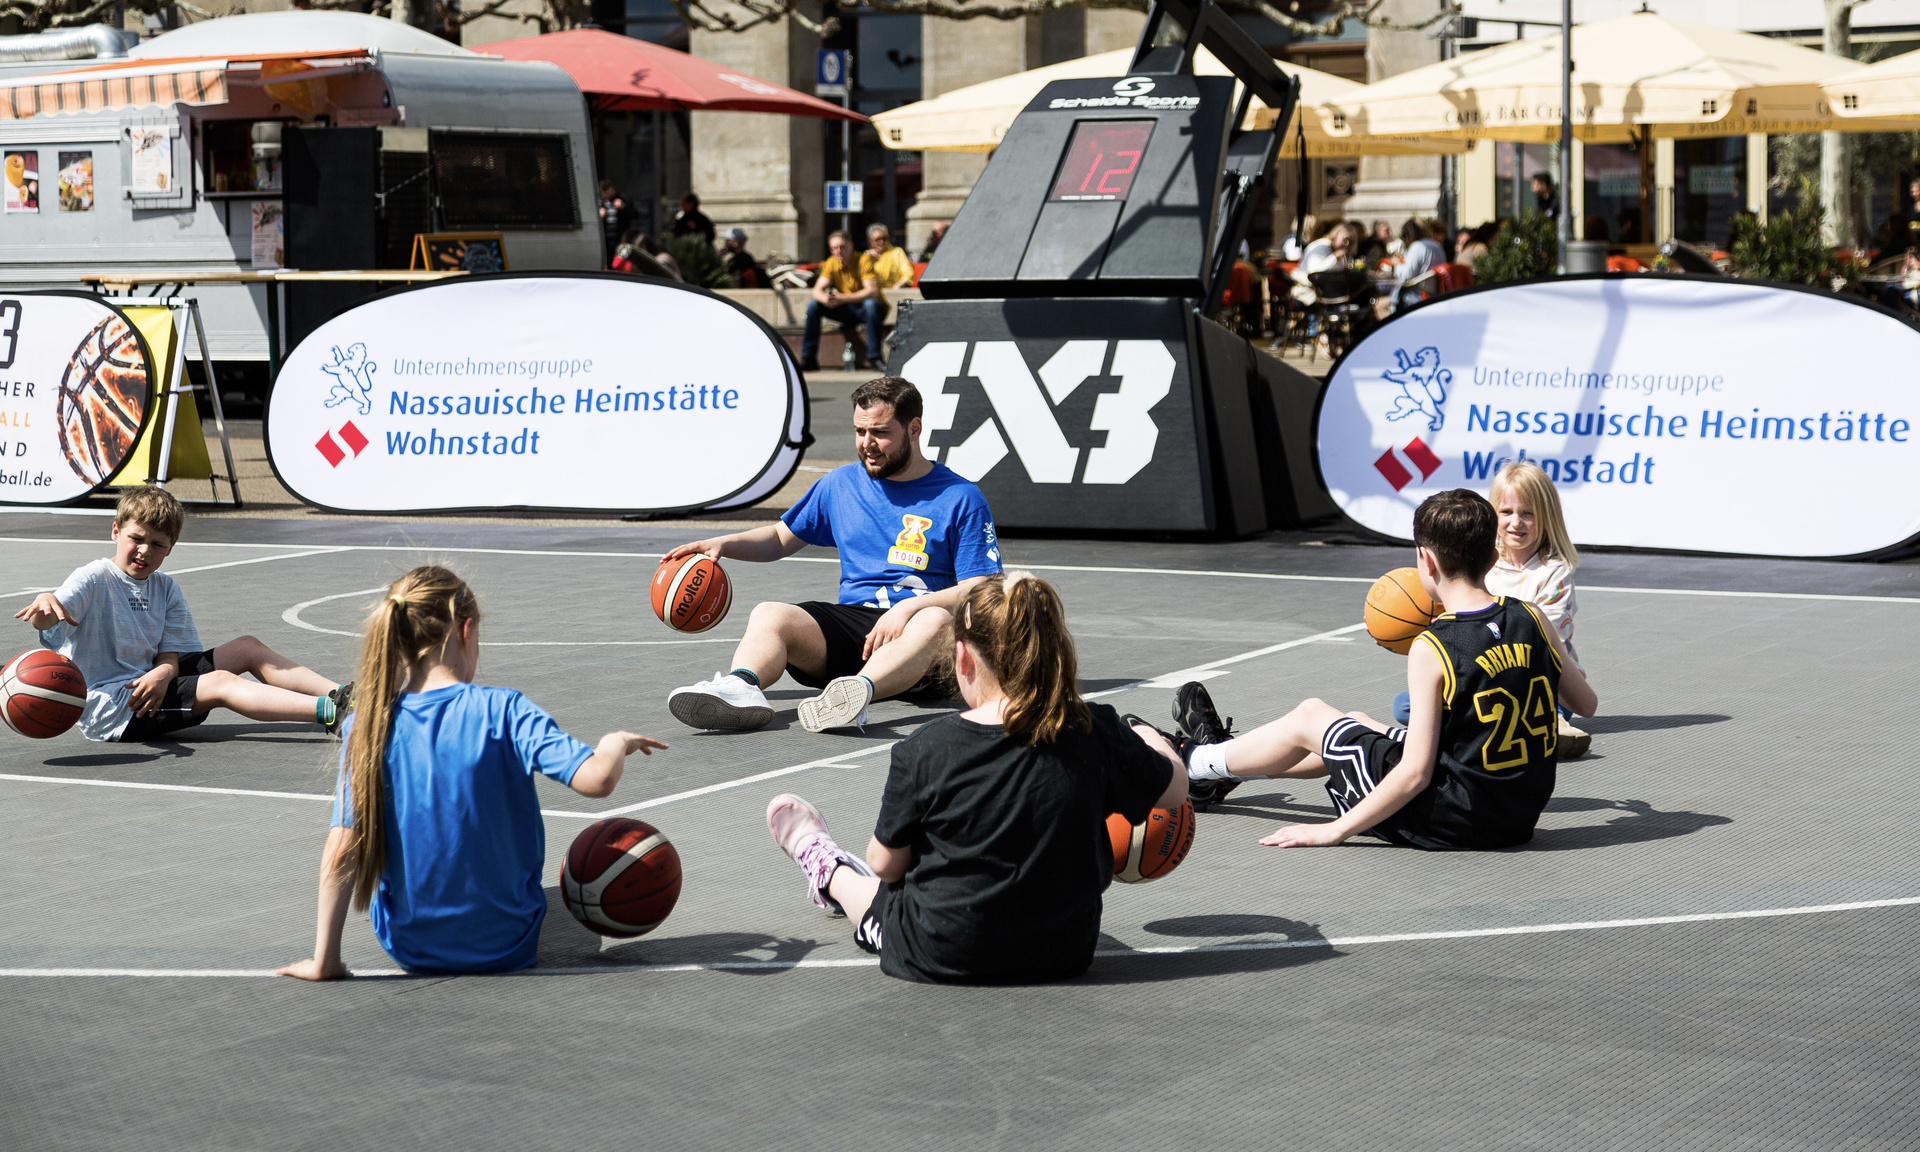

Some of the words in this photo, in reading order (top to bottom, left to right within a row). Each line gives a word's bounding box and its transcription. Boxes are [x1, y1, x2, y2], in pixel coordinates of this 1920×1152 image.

[1049, 96, 1130, 109] Schelde
[1131, 95, 1200, 108] Sports
[1079, 149, 1142, 193] 12
[393, 356, 593, 380] Unternehmensgruppe
[1473, 365, 1724, 396] Unternehmensgruppe
[388, 387, 566, 415] Nassauische
[573, 384, 740, 413] Heimstätte
[1466, 403, 1689, 438] Nassauische
[1698, 407, 1911, 443] Heimstätte
[385, 427, 541, 456] Wohnstadt
[894, 550, 923, 566] TOUR
[675, 567, 708, 618] molten
[1474, 642, 1533, 680] BRYANT
[1472, 675, 1558, 772] 24
[1151, 812, 1165, 823] 5
